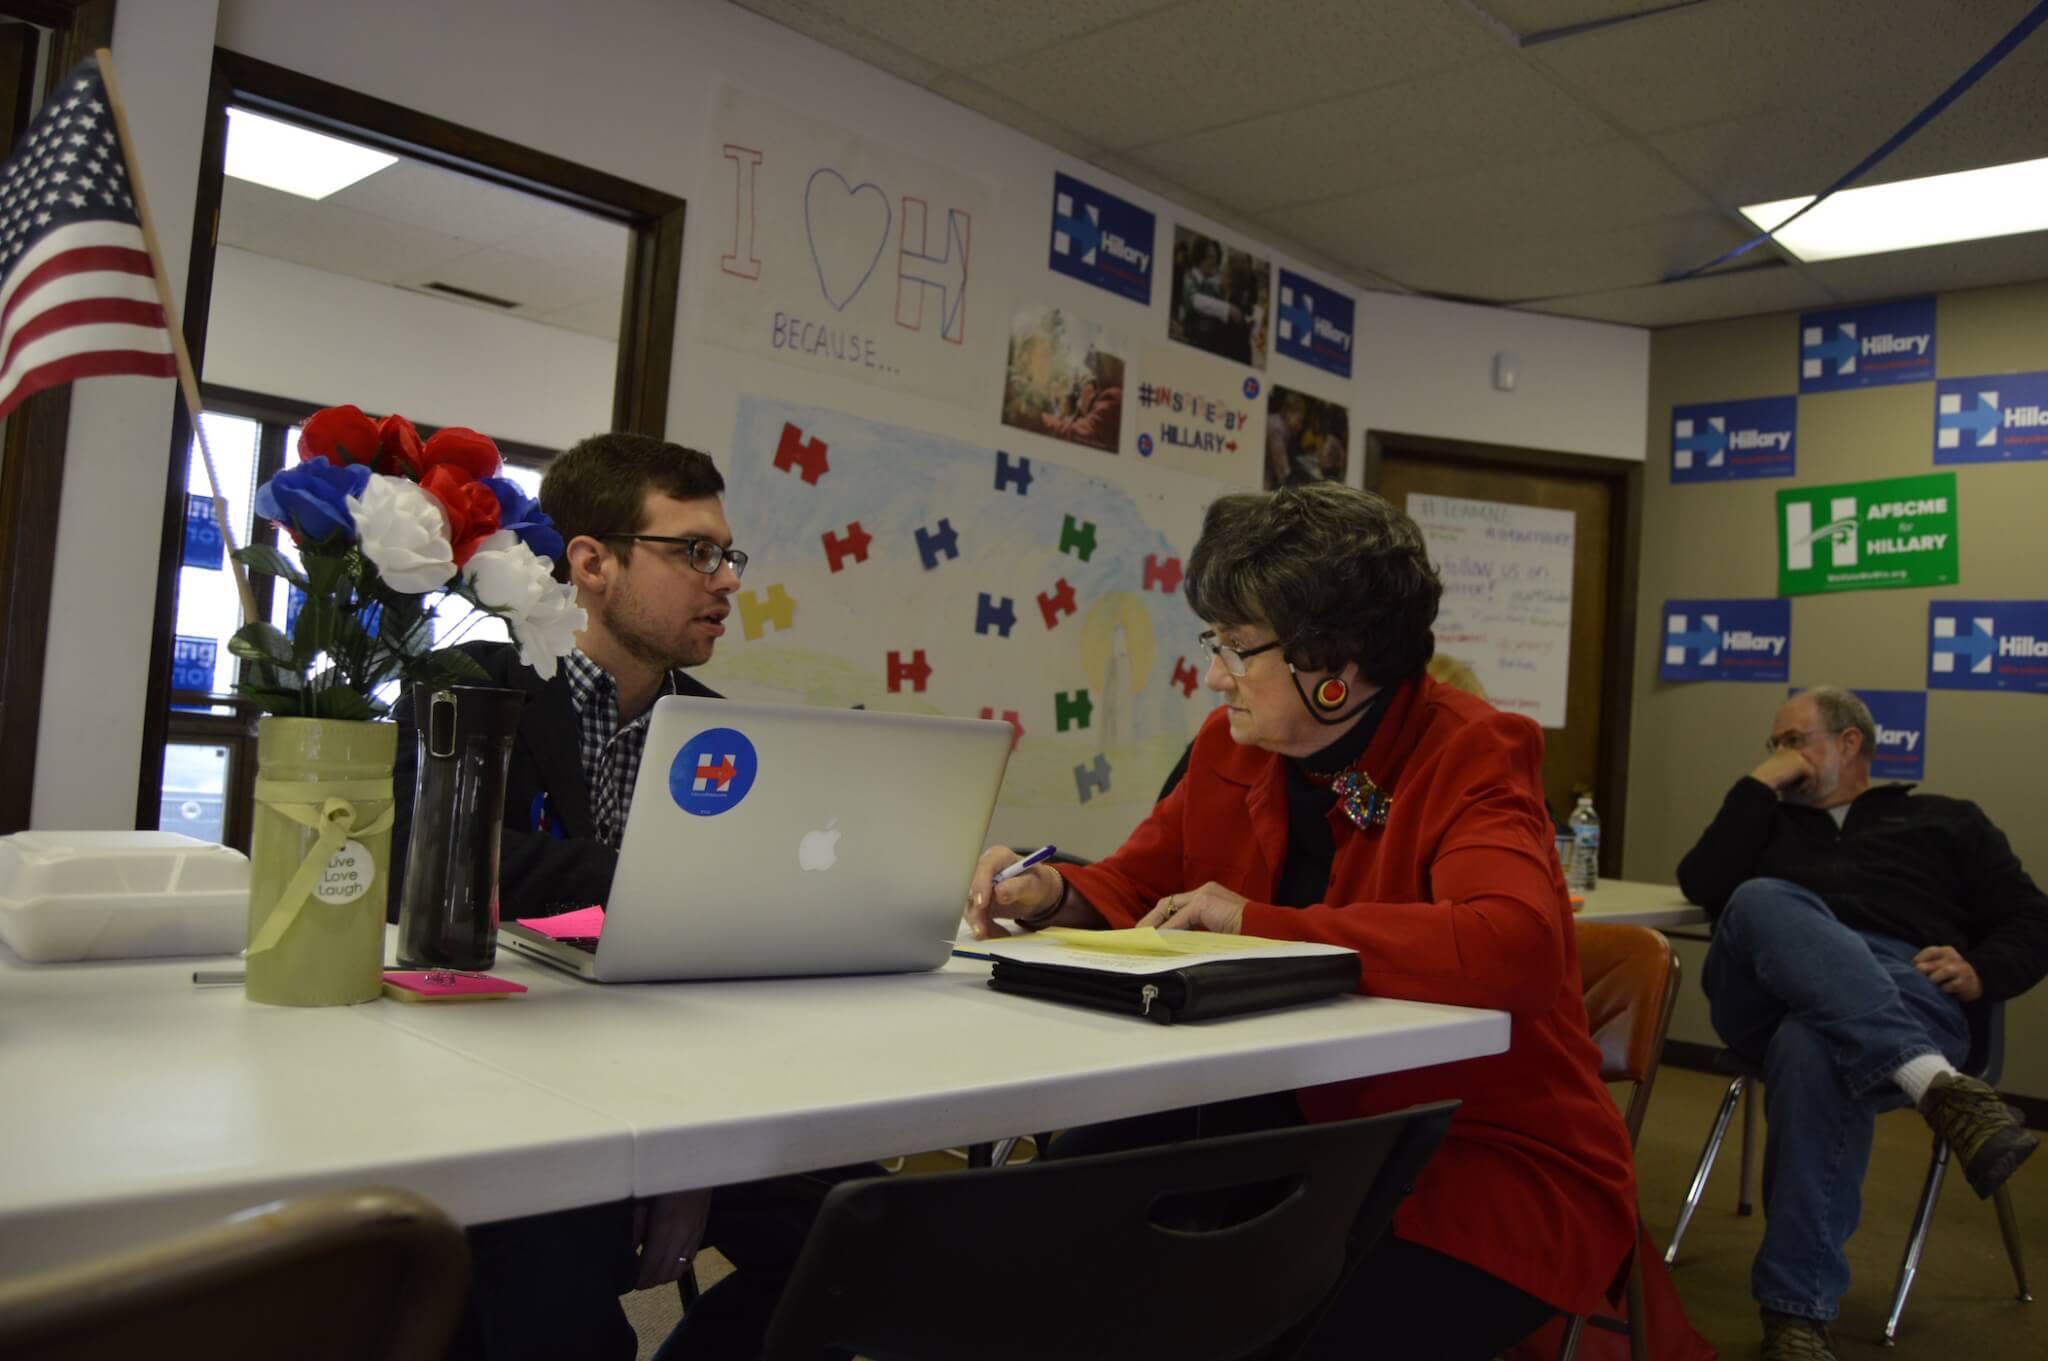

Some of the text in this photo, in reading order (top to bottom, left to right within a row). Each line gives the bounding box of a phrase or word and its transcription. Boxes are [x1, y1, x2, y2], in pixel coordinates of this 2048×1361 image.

[1101, 230, 1151, 274] Hillary
[1313, 316, 1352, 351] Hillary
[1861, 334, 1930, 357] Hillary
[1160, 422, 1226, 454] HILLARY
[1729, 429, 1792, 452] Hillary
[1866, 497, 1948, 520] AFSCME
[1866, 534, 1948, 556] HILLARY
[1722, 630, 1786, 656] Hillary
[324, 871, 358, 882] Love
[318, 883, 362, 896] Laugh
